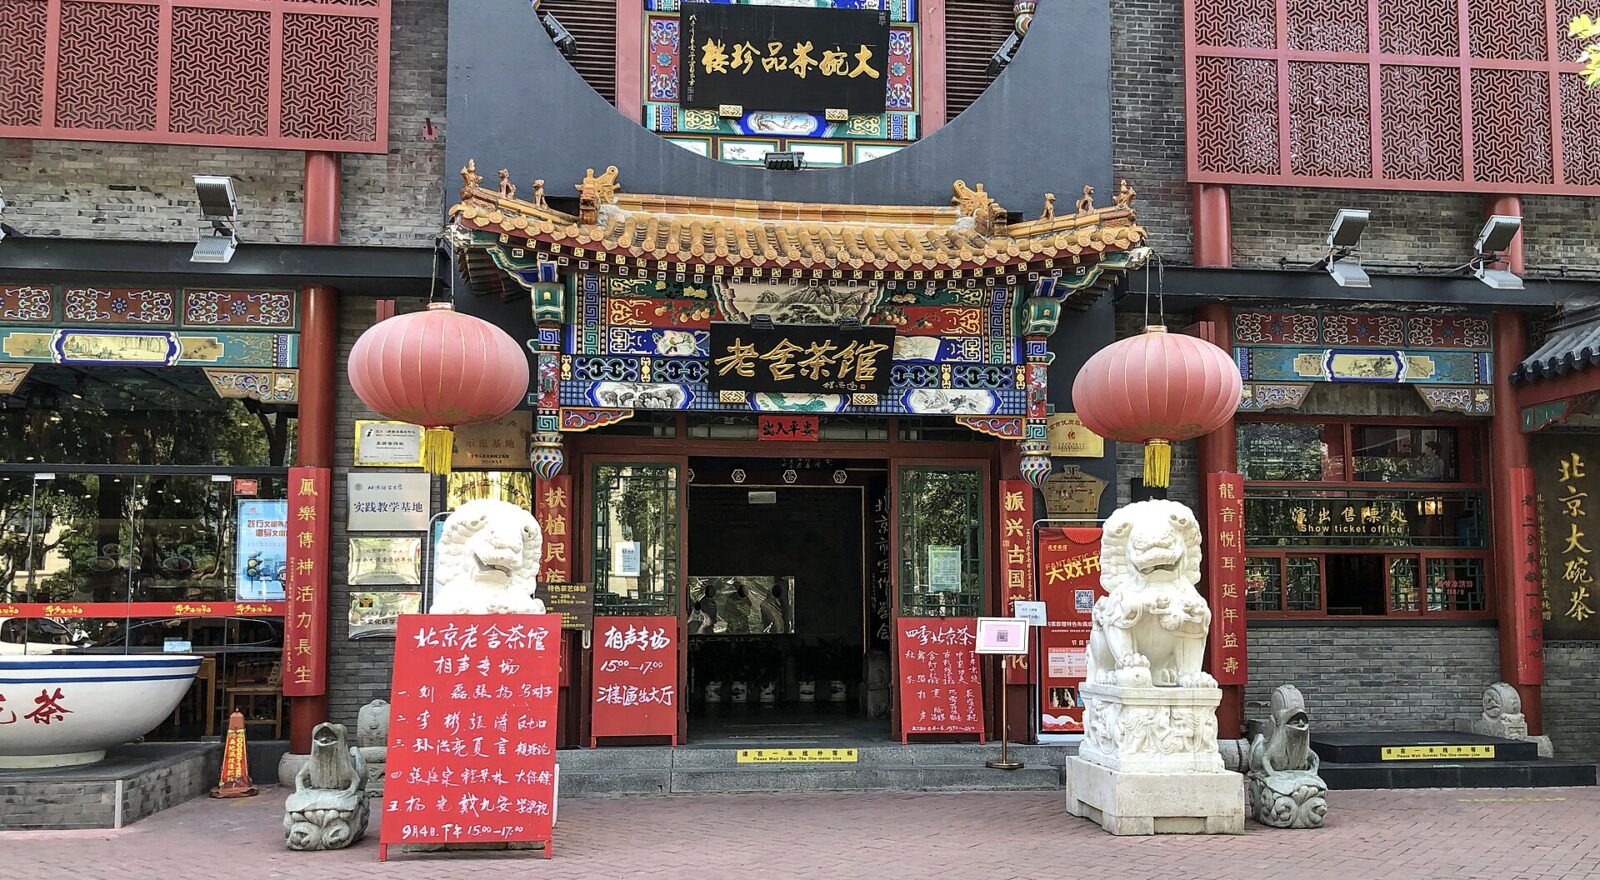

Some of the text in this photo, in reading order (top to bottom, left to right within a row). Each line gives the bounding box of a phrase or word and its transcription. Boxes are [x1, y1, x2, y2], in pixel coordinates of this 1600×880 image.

[762, 420, 815, 436] 出入平安
[354, 502, 424, 512] 实践教学基地
[1291, 506, 1408, 524] 演出售票处
[1301, 525, 1403, 533] Show ticket office
[1558, 452, 1596, 622] 北京大碗茶
[1045, 552, 1089, 571] FANTASTIC
[414, 623, 549, 650] 北京老舍茶馆
[604, 624, 670, 651] 相声专场
[905, 625, 976, 645] 四季北京茶
[434, 654, 520, 676] 相声专场
[1387, 746, 1491, 754] 请在一米线外等候
